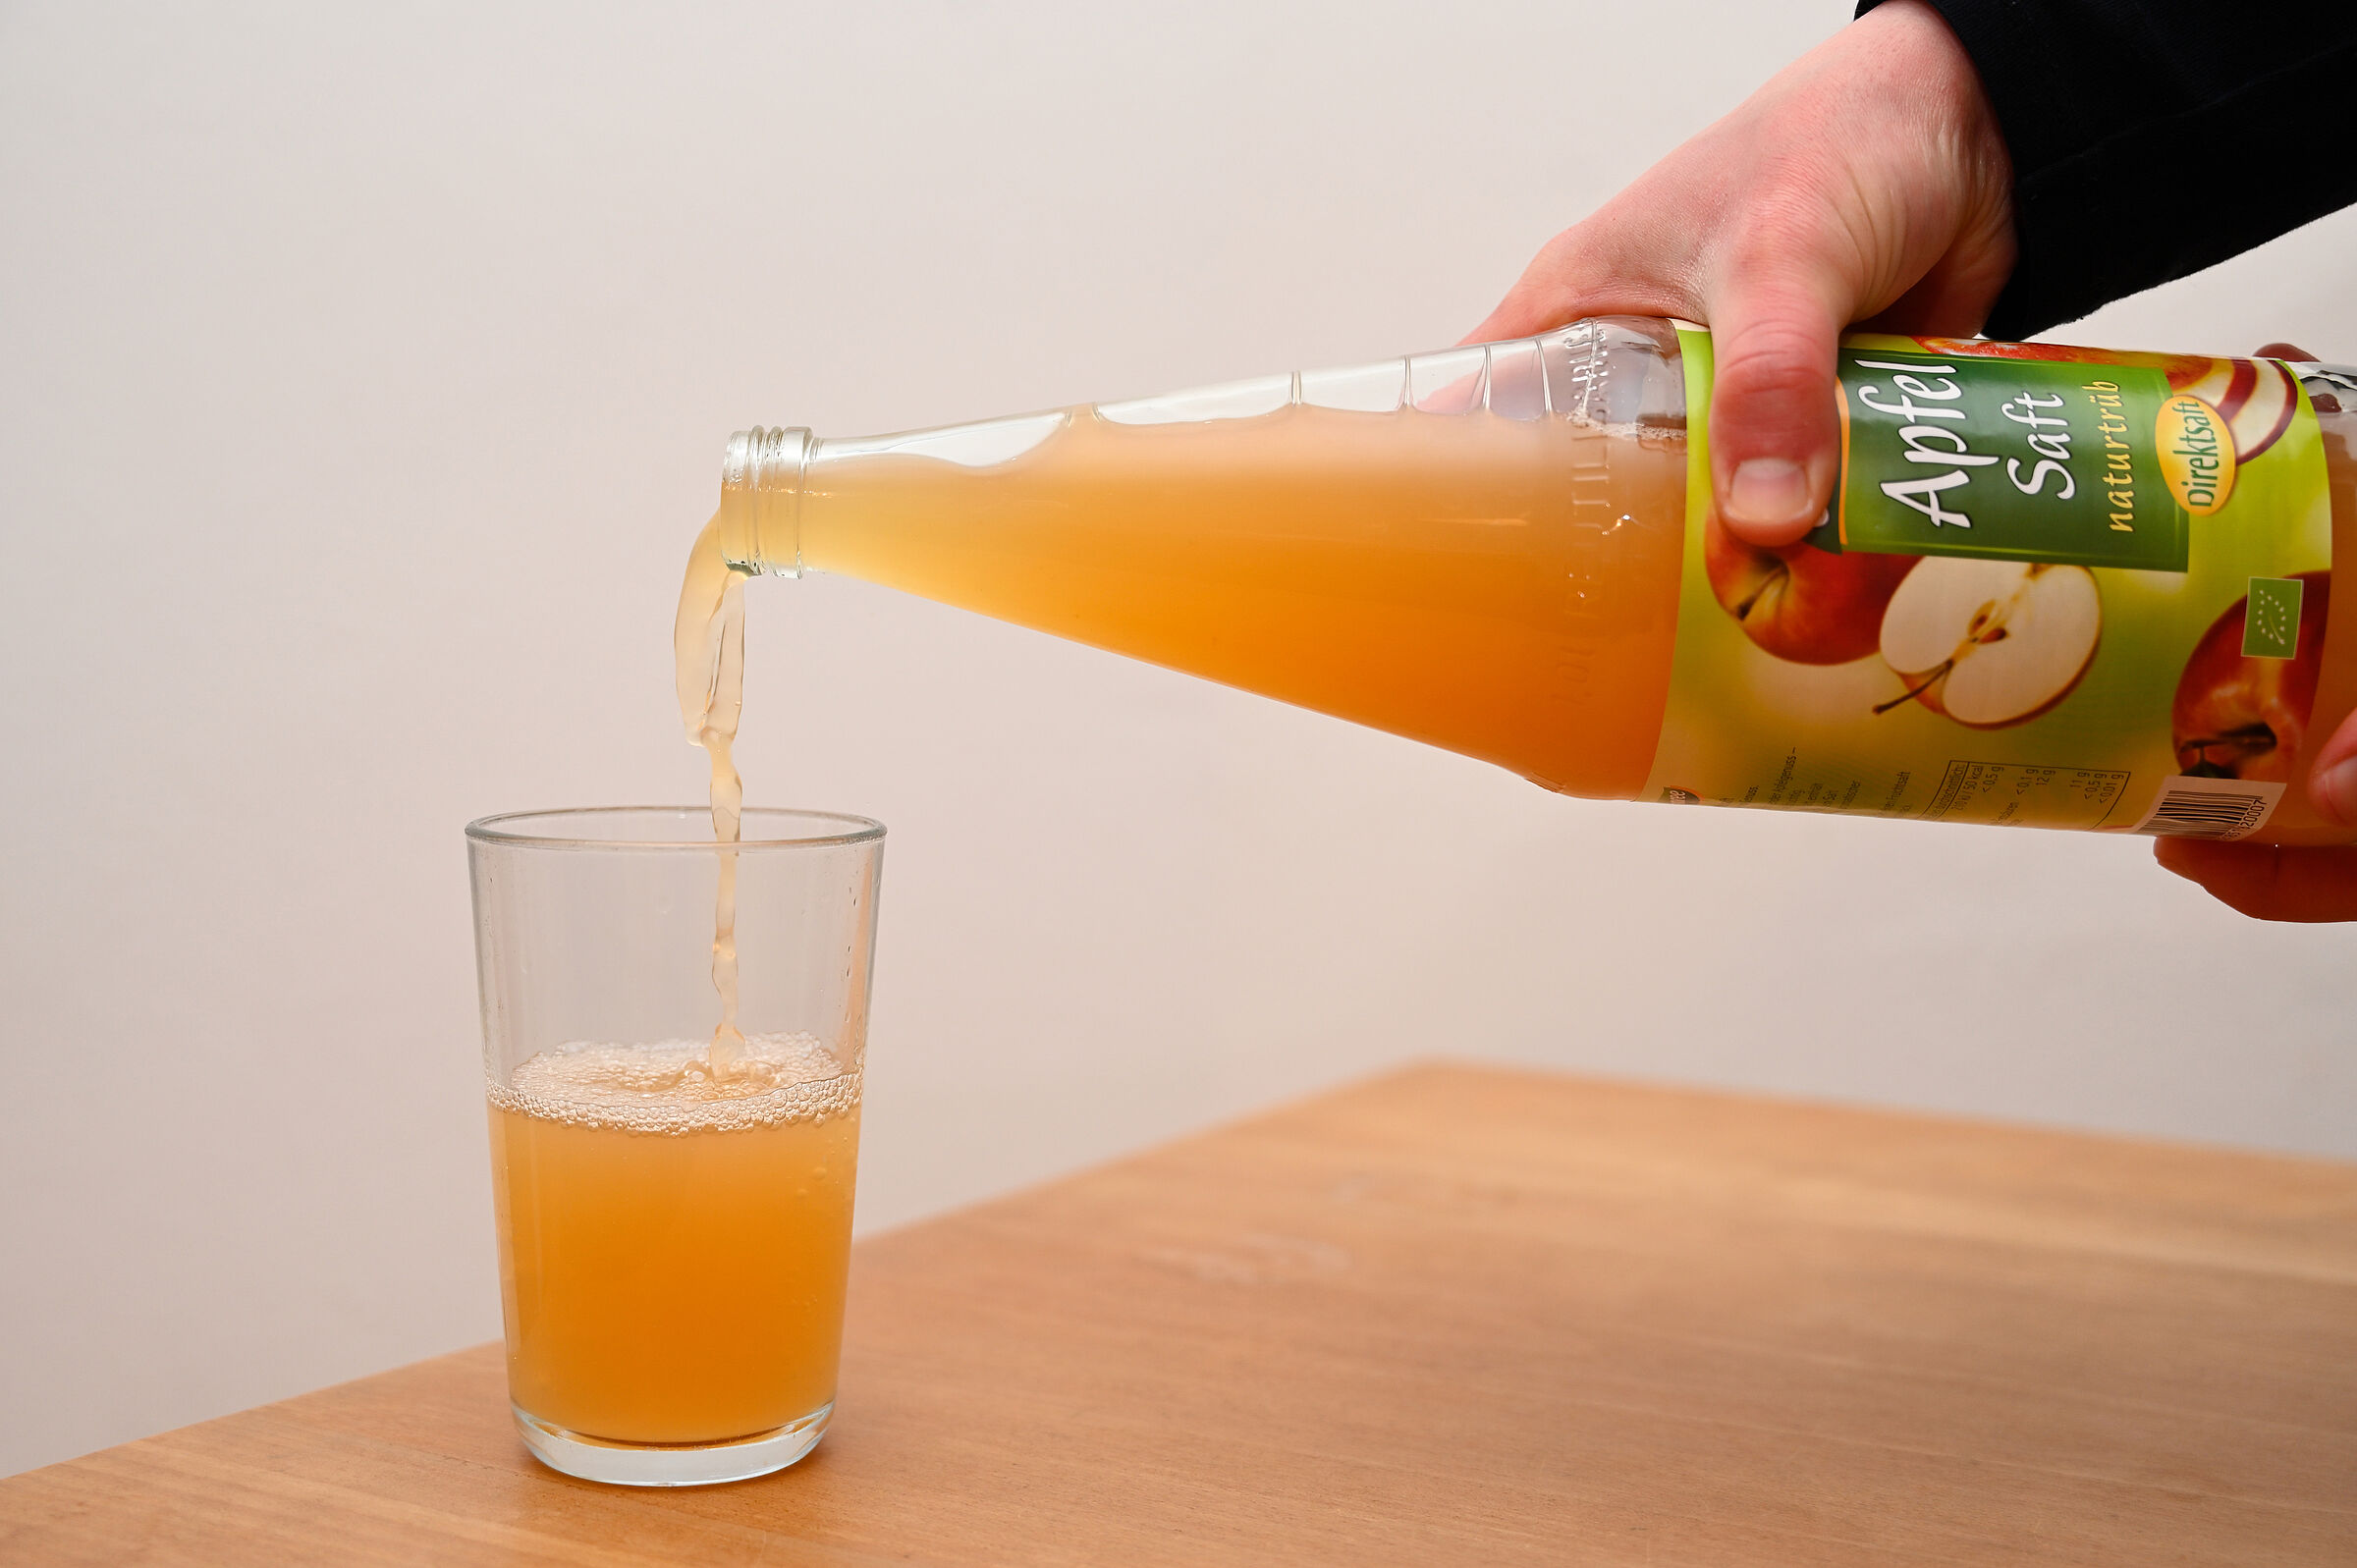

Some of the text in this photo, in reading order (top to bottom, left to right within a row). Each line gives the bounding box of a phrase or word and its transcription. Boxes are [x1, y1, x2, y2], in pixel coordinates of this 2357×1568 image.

[1854, 358, 2000, 529] Apfel
[2001, 391, 2076, 501] Saft
[2082, 379, 2136, 533] naturtrüb
[2172, 401, 2220, 508] Direktsaft
[2035, 777, 2050, 786] 12
